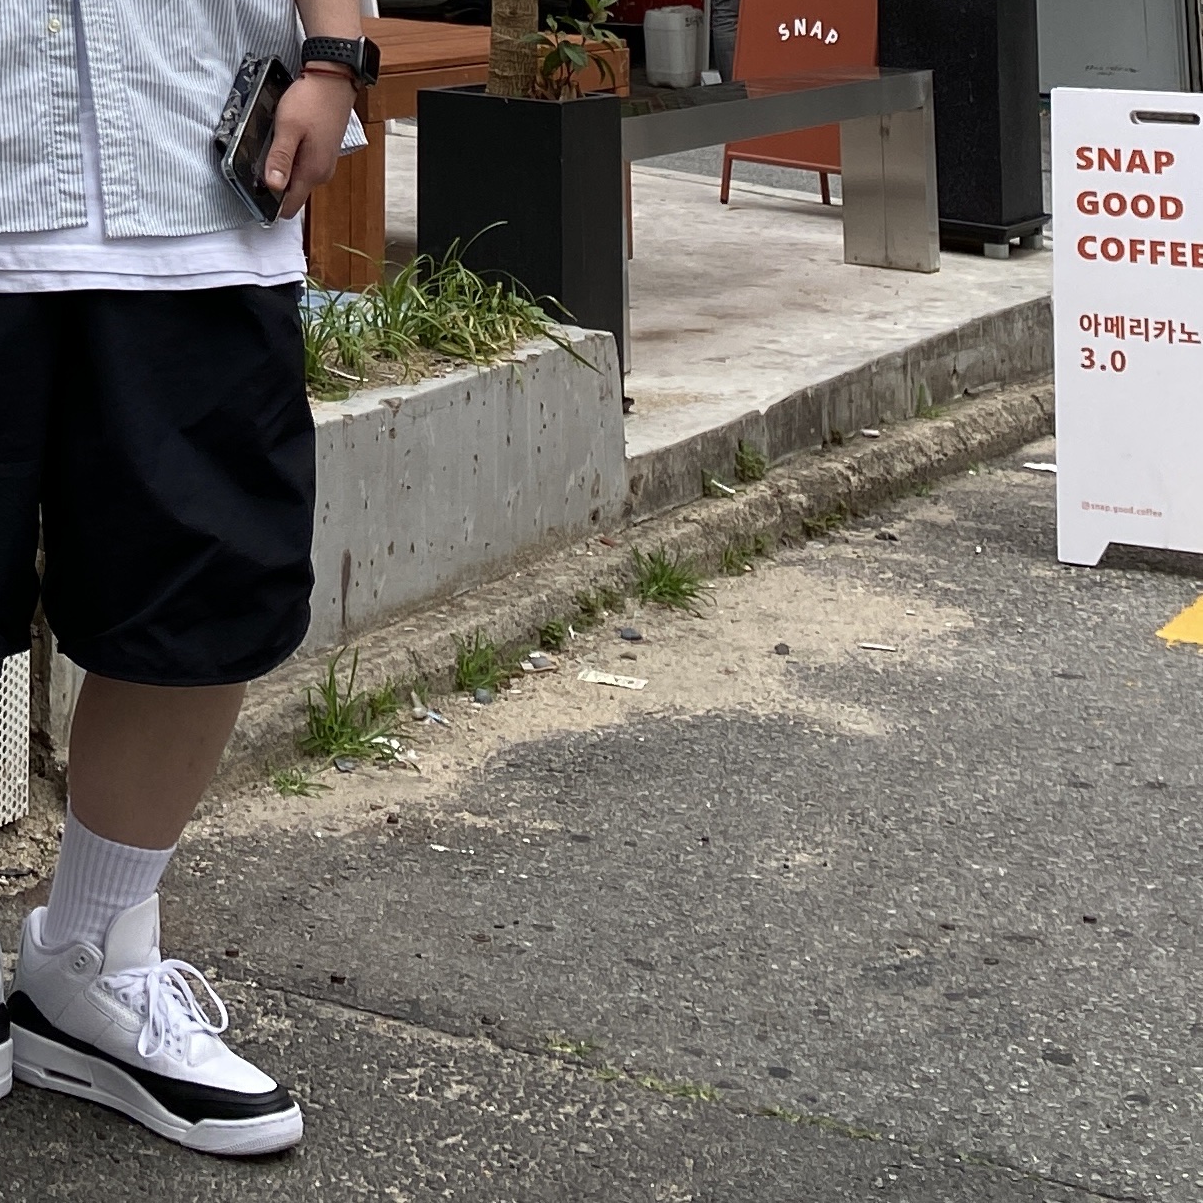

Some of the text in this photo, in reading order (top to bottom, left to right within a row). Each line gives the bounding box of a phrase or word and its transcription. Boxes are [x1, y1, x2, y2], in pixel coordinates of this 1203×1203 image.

[778, 17, 839, 45] SNAP
[1075, 146, 1175, 175] SNAP
[1076, 190, 1184, 220] GOOD
[1077, 235, 1203, 268] COFFEE
[1079, 313, 1202, 345] 아메리카노
[1080, 347, 1127, 373] 3.0
